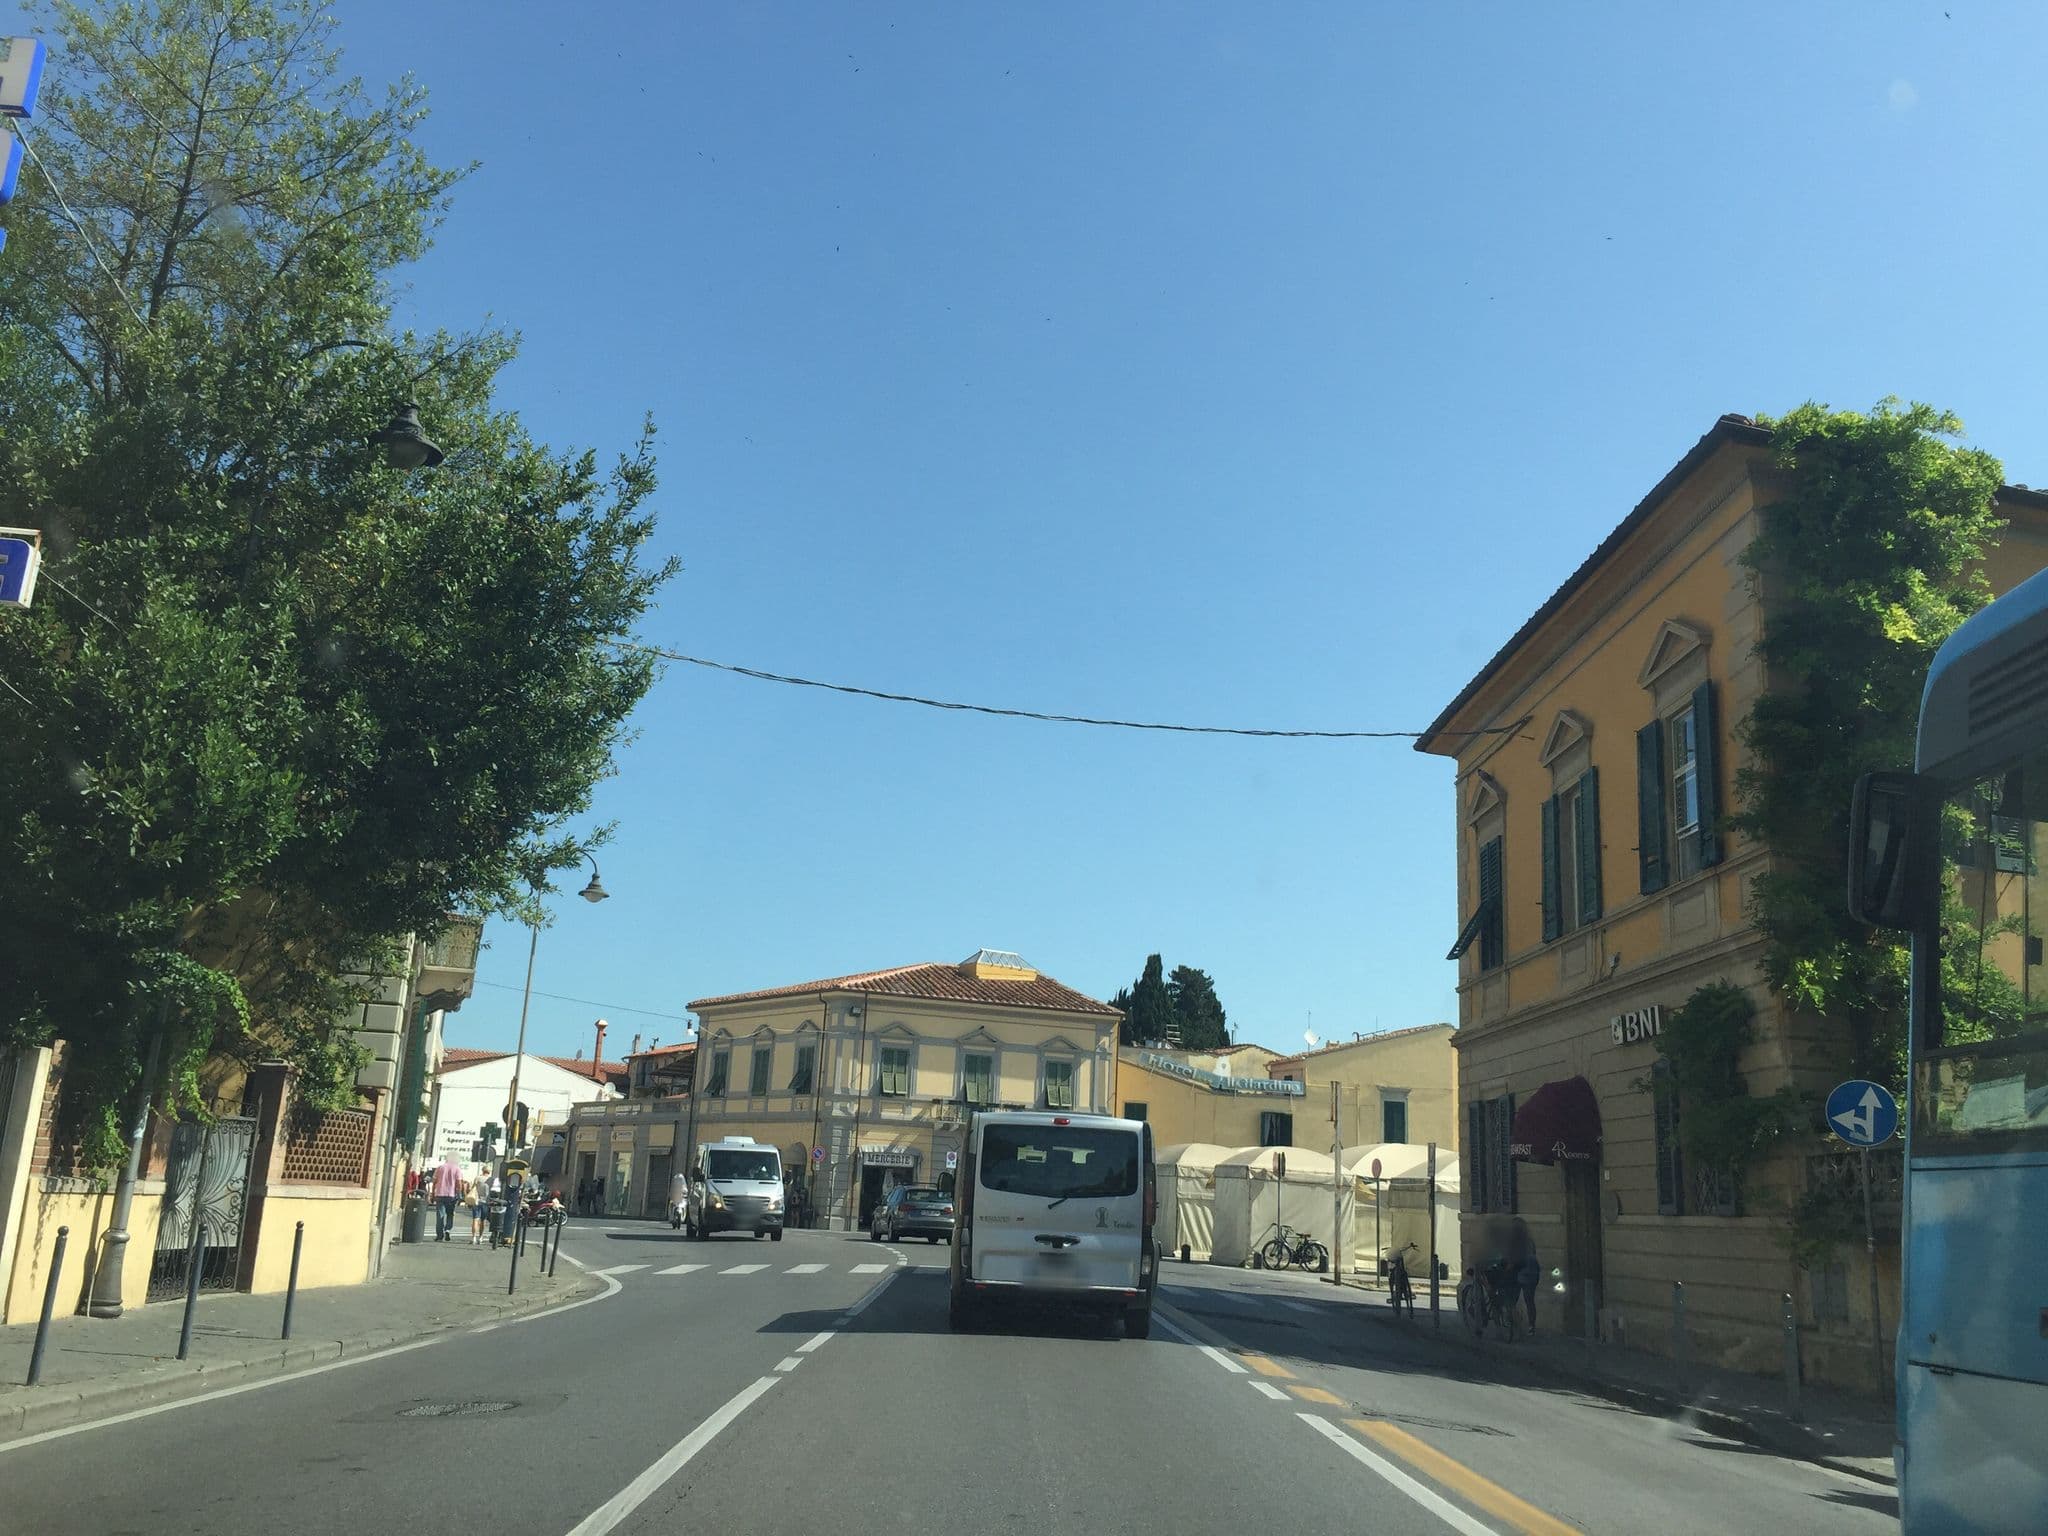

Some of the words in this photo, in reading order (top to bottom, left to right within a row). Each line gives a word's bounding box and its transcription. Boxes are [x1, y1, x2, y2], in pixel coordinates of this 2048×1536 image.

[1149, 1053, 1198, 1080] Hotel
[1236, 1078, 1300, 1093] Giardino
[867, 1153, 911, 1165] MERCERIE
